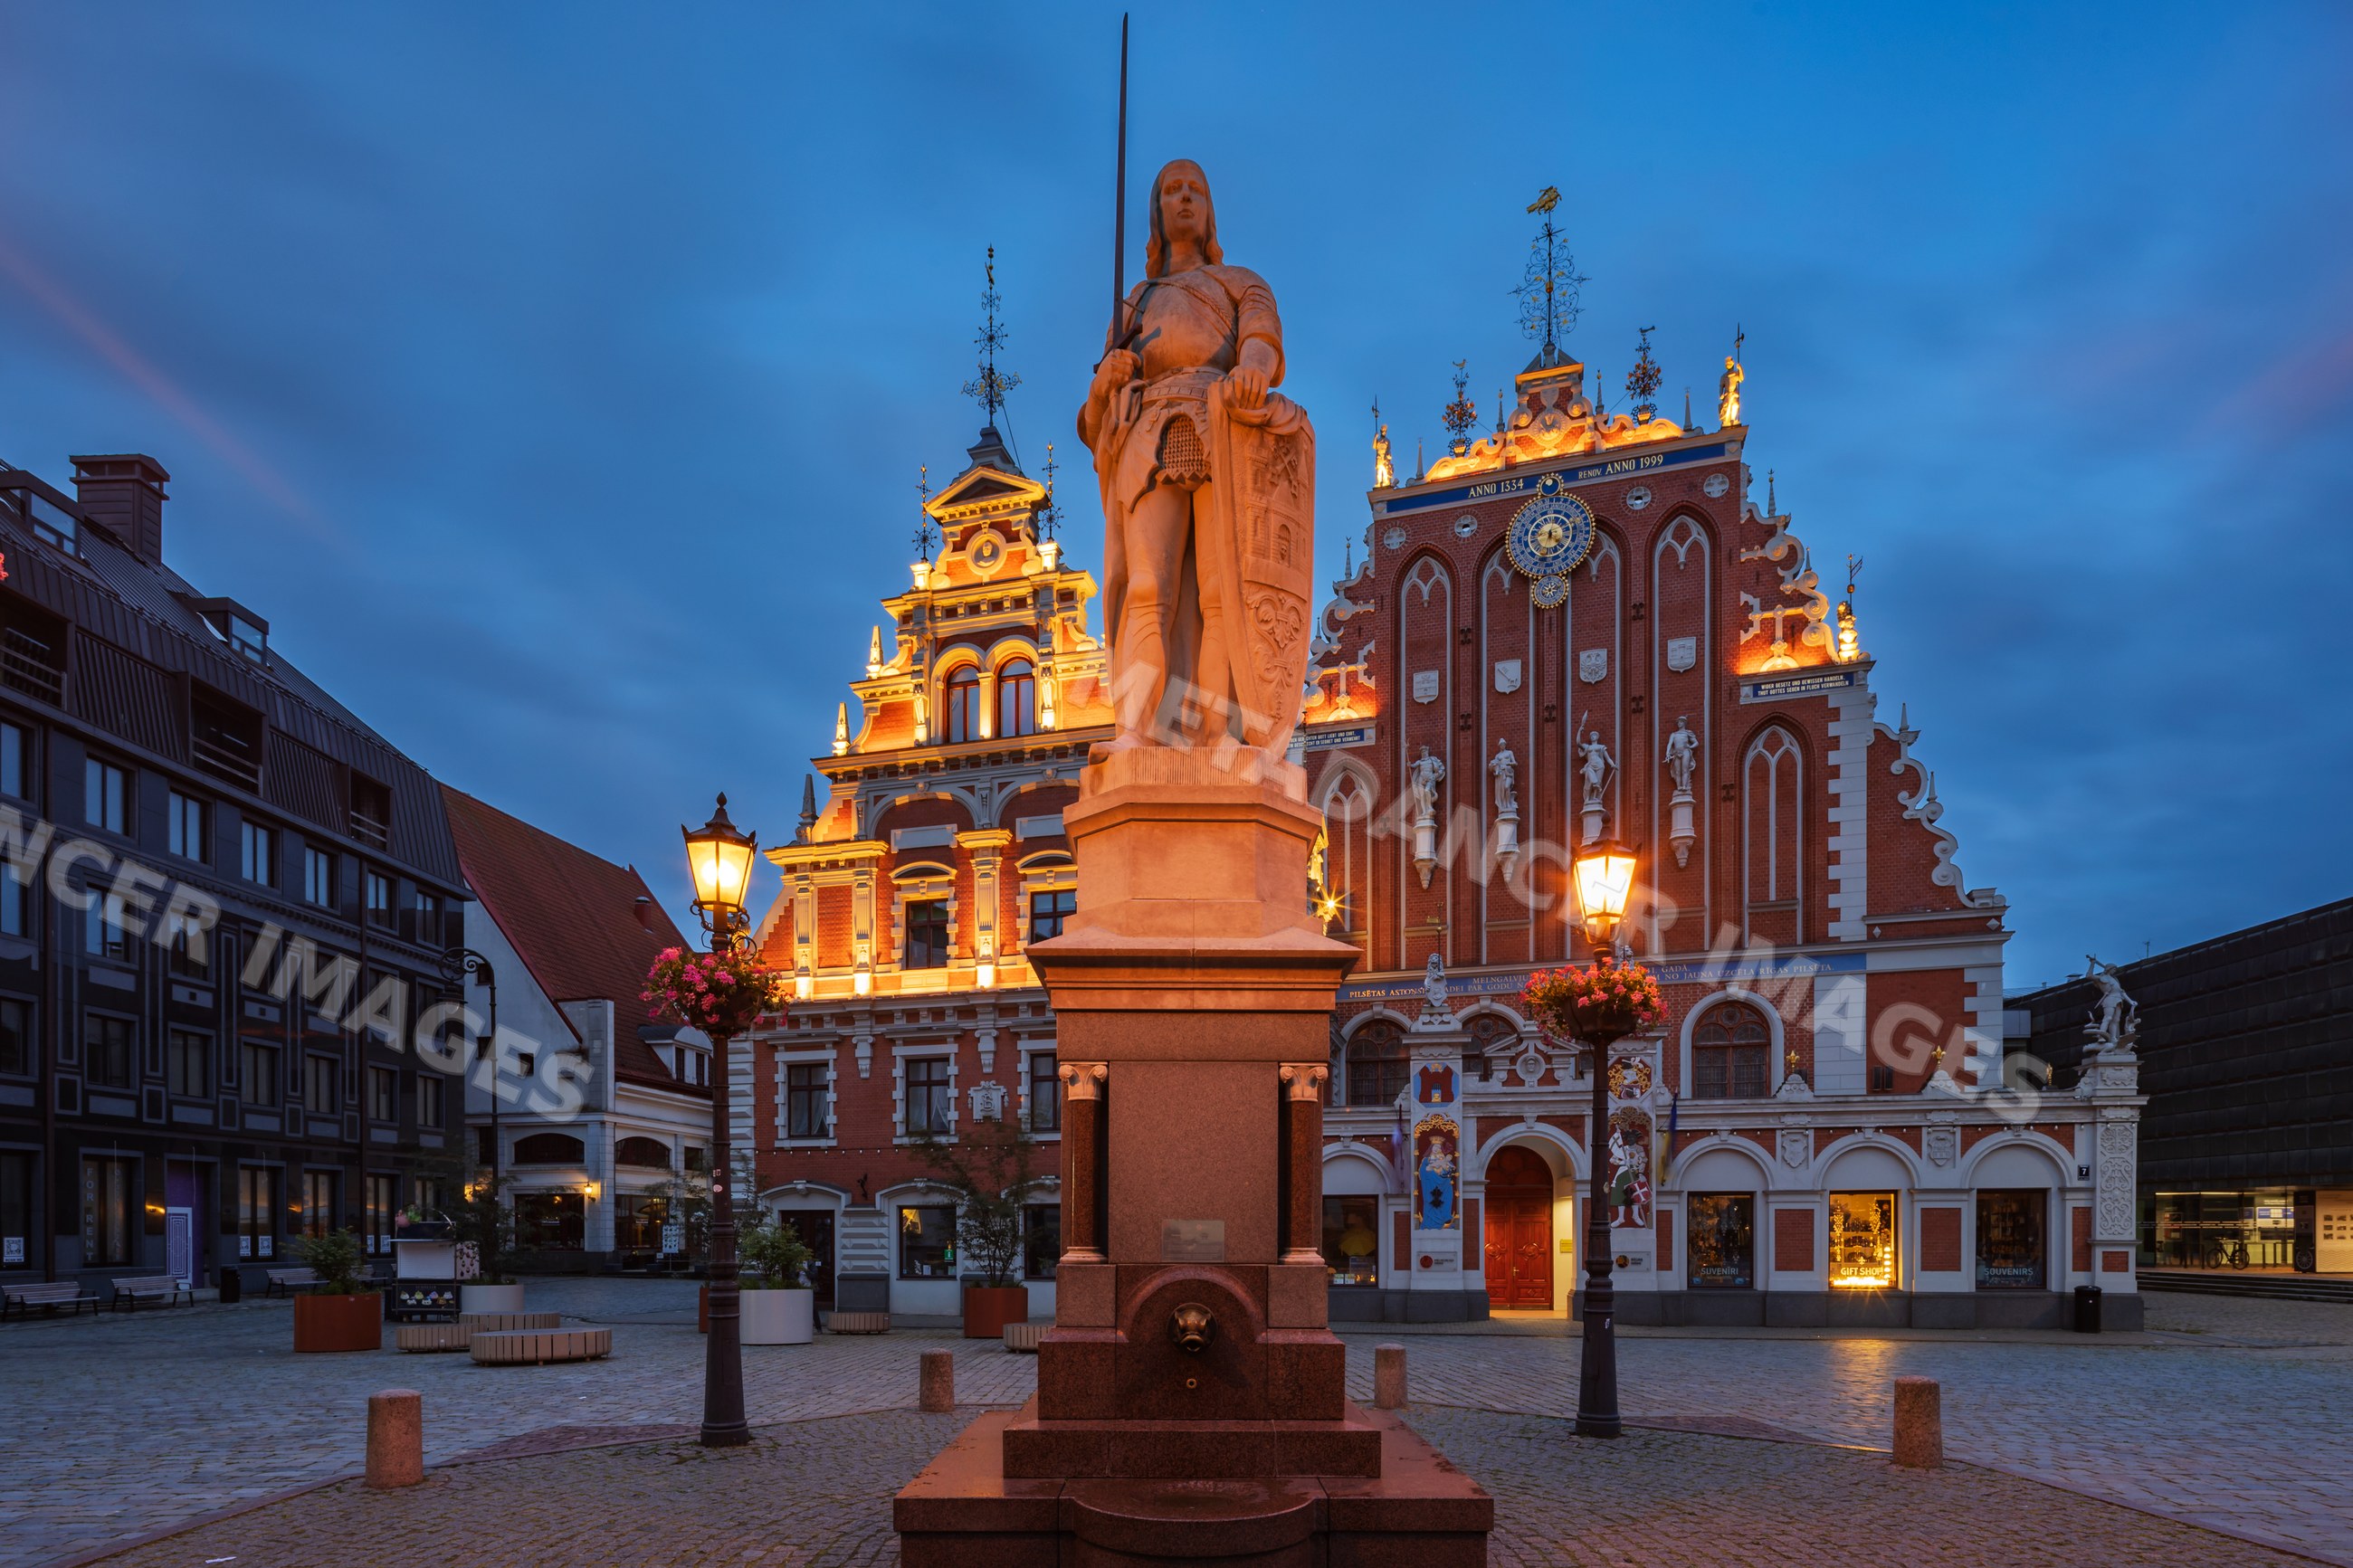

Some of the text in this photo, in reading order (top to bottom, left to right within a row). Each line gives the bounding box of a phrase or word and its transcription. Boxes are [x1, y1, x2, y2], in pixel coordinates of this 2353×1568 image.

[1605, 459, 1635, 475] ANNO
[1640, 454, 1663, 470] 1999
[1468, 478, 1524, 499] ANNO 1334
[1684, 971, 1713, 980] JAUNA
[1700, 1266, 1739, 1276] SUVENĪRI
[1840, 1267, 1858, 1276] GIFT
[1985, 1267, 2034, 1276] SOUVENIRS
